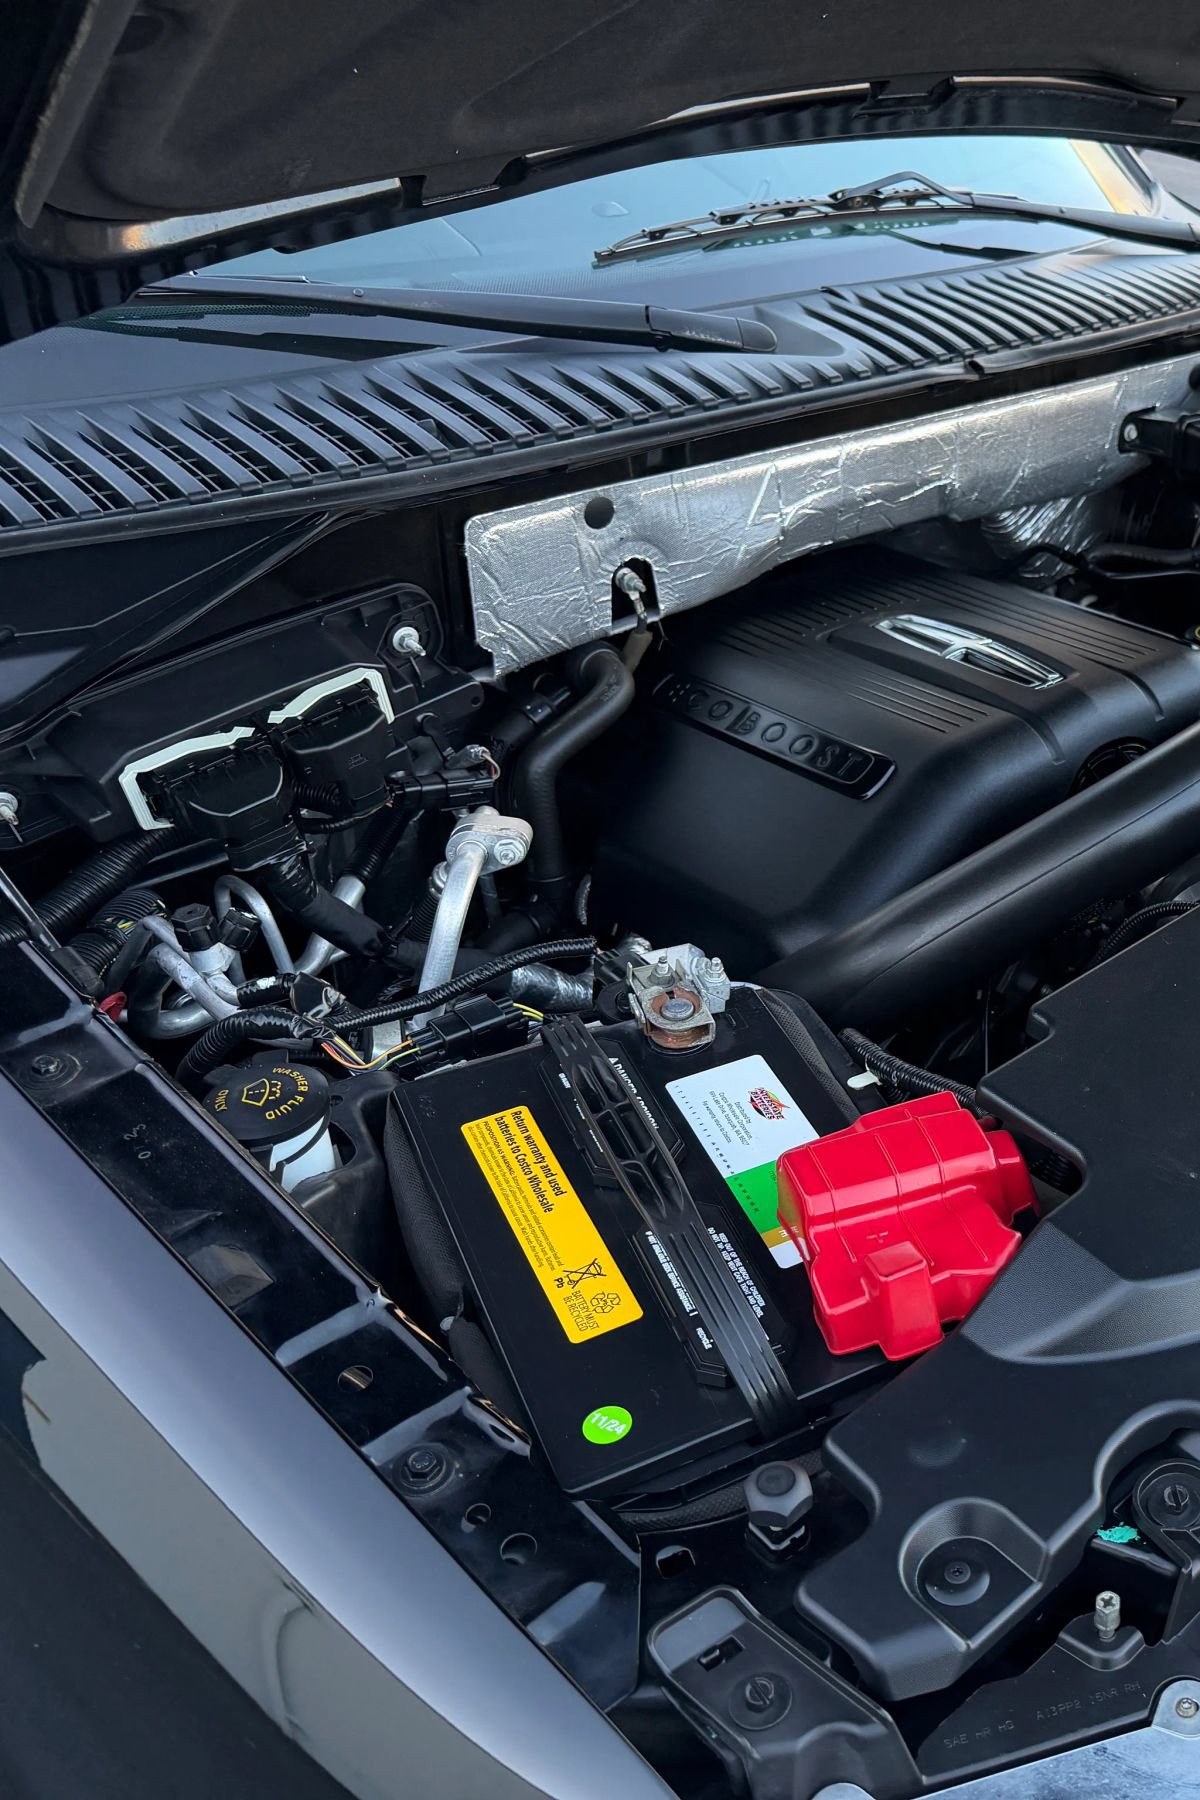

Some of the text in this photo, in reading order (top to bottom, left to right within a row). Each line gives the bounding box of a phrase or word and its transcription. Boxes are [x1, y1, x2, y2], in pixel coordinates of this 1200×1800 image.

[214, 1067, 308, 1120] WASHER FLUID ONLY
[750, 1091, 775, 1120] BATTERIES
[756, 1087, 784, 1120] INTERSTATE
[482, 1121, 501, 1149] PROPOSITION
[495, 1115, 554, 1213] batteries to Costco Wholesale
[511, 1110, 567, 1196] Return warranty and used
[711, 1234, 721, 1242] NOT
[724, 1243, 734, 1251] OUT
[733, 1258, 742, 1267] THE
[554, 1278, 565, 1288] Pb
[563, 1296, 588, 1332] BE RECYCLED
[571, 1290, 599, 1330] BATTERY MUST
[591, 1411, 627, 1435] 11/24
[943, 1733, 969, 1748] SAE
